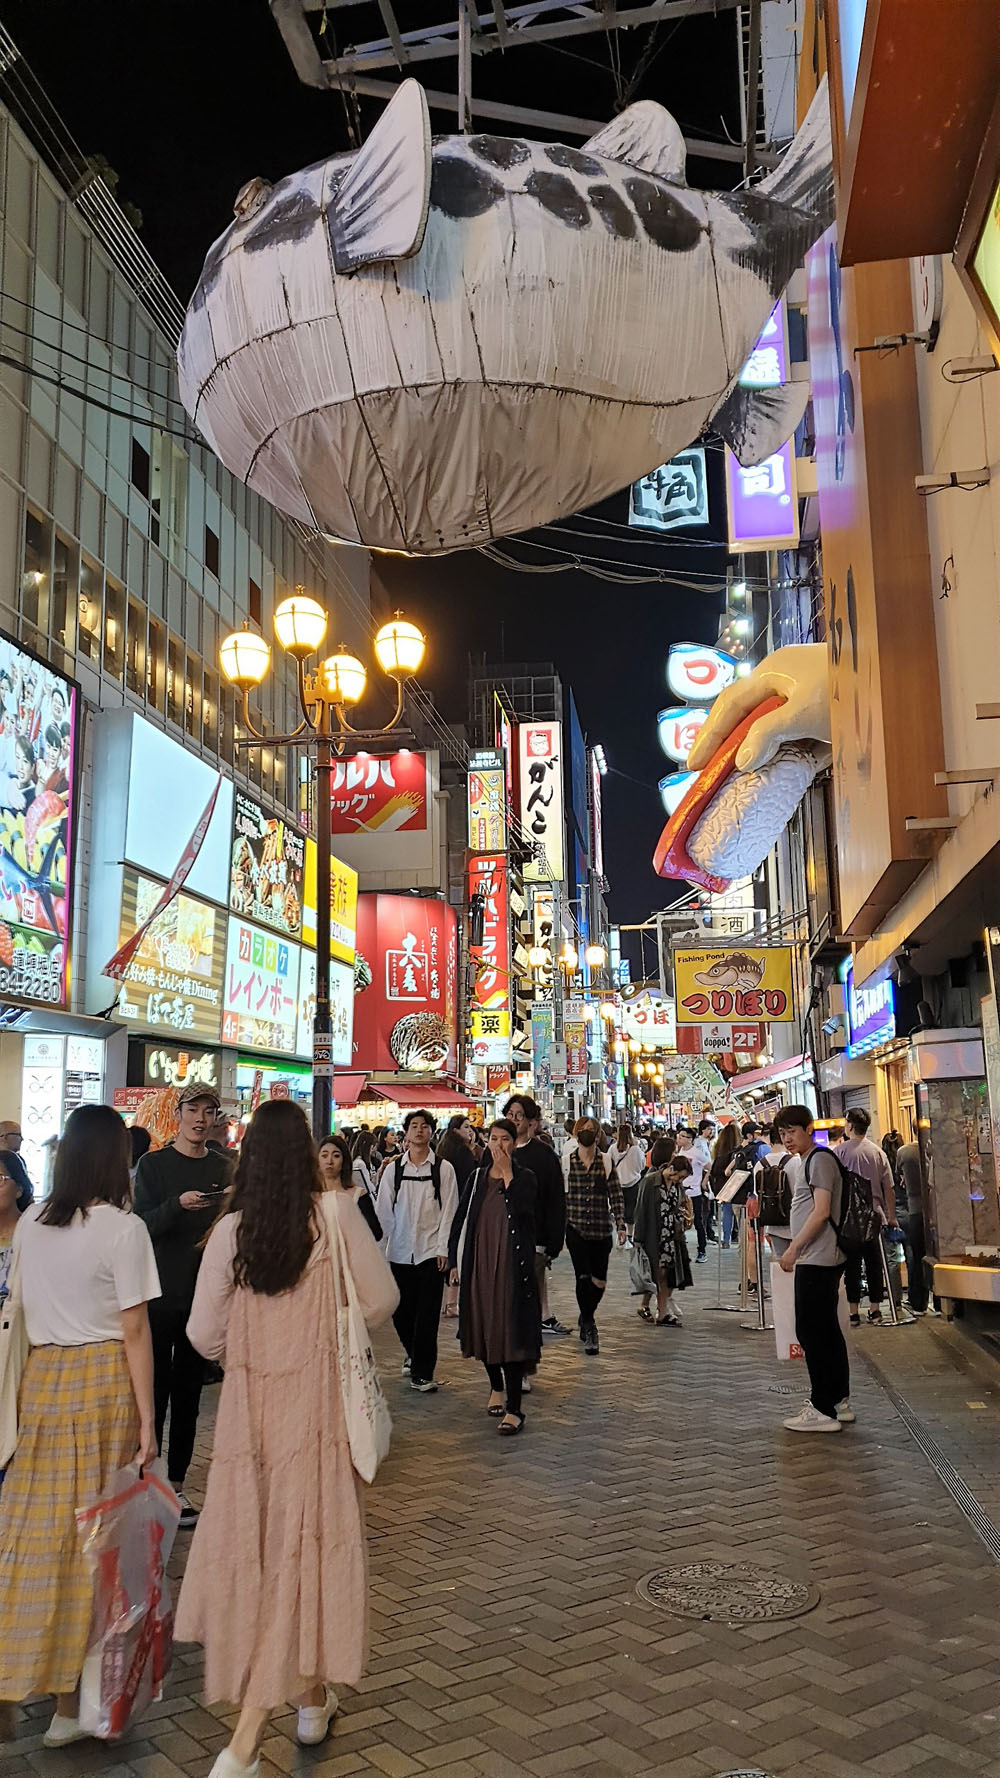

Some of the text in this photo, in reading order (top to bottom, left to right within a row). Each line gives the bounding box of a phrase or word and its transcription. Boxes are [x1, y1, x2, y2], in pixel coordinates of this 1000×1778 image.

[642, 469, 696, 507] 牛角
[720, 916, 745, 934] 酒
[240, 931, 288, 974] カラオケ
[677, 952, 726, 964] Fishing Pond
[229, 963, 294, 1017] レインボー
[681, 988, 788, 1017] つりぼり
[223, 1014, 238, 1039] 4F
[481, 1014, 500, 1034] 薬
[704, 1032, 758, 1049] doppa! 2F
